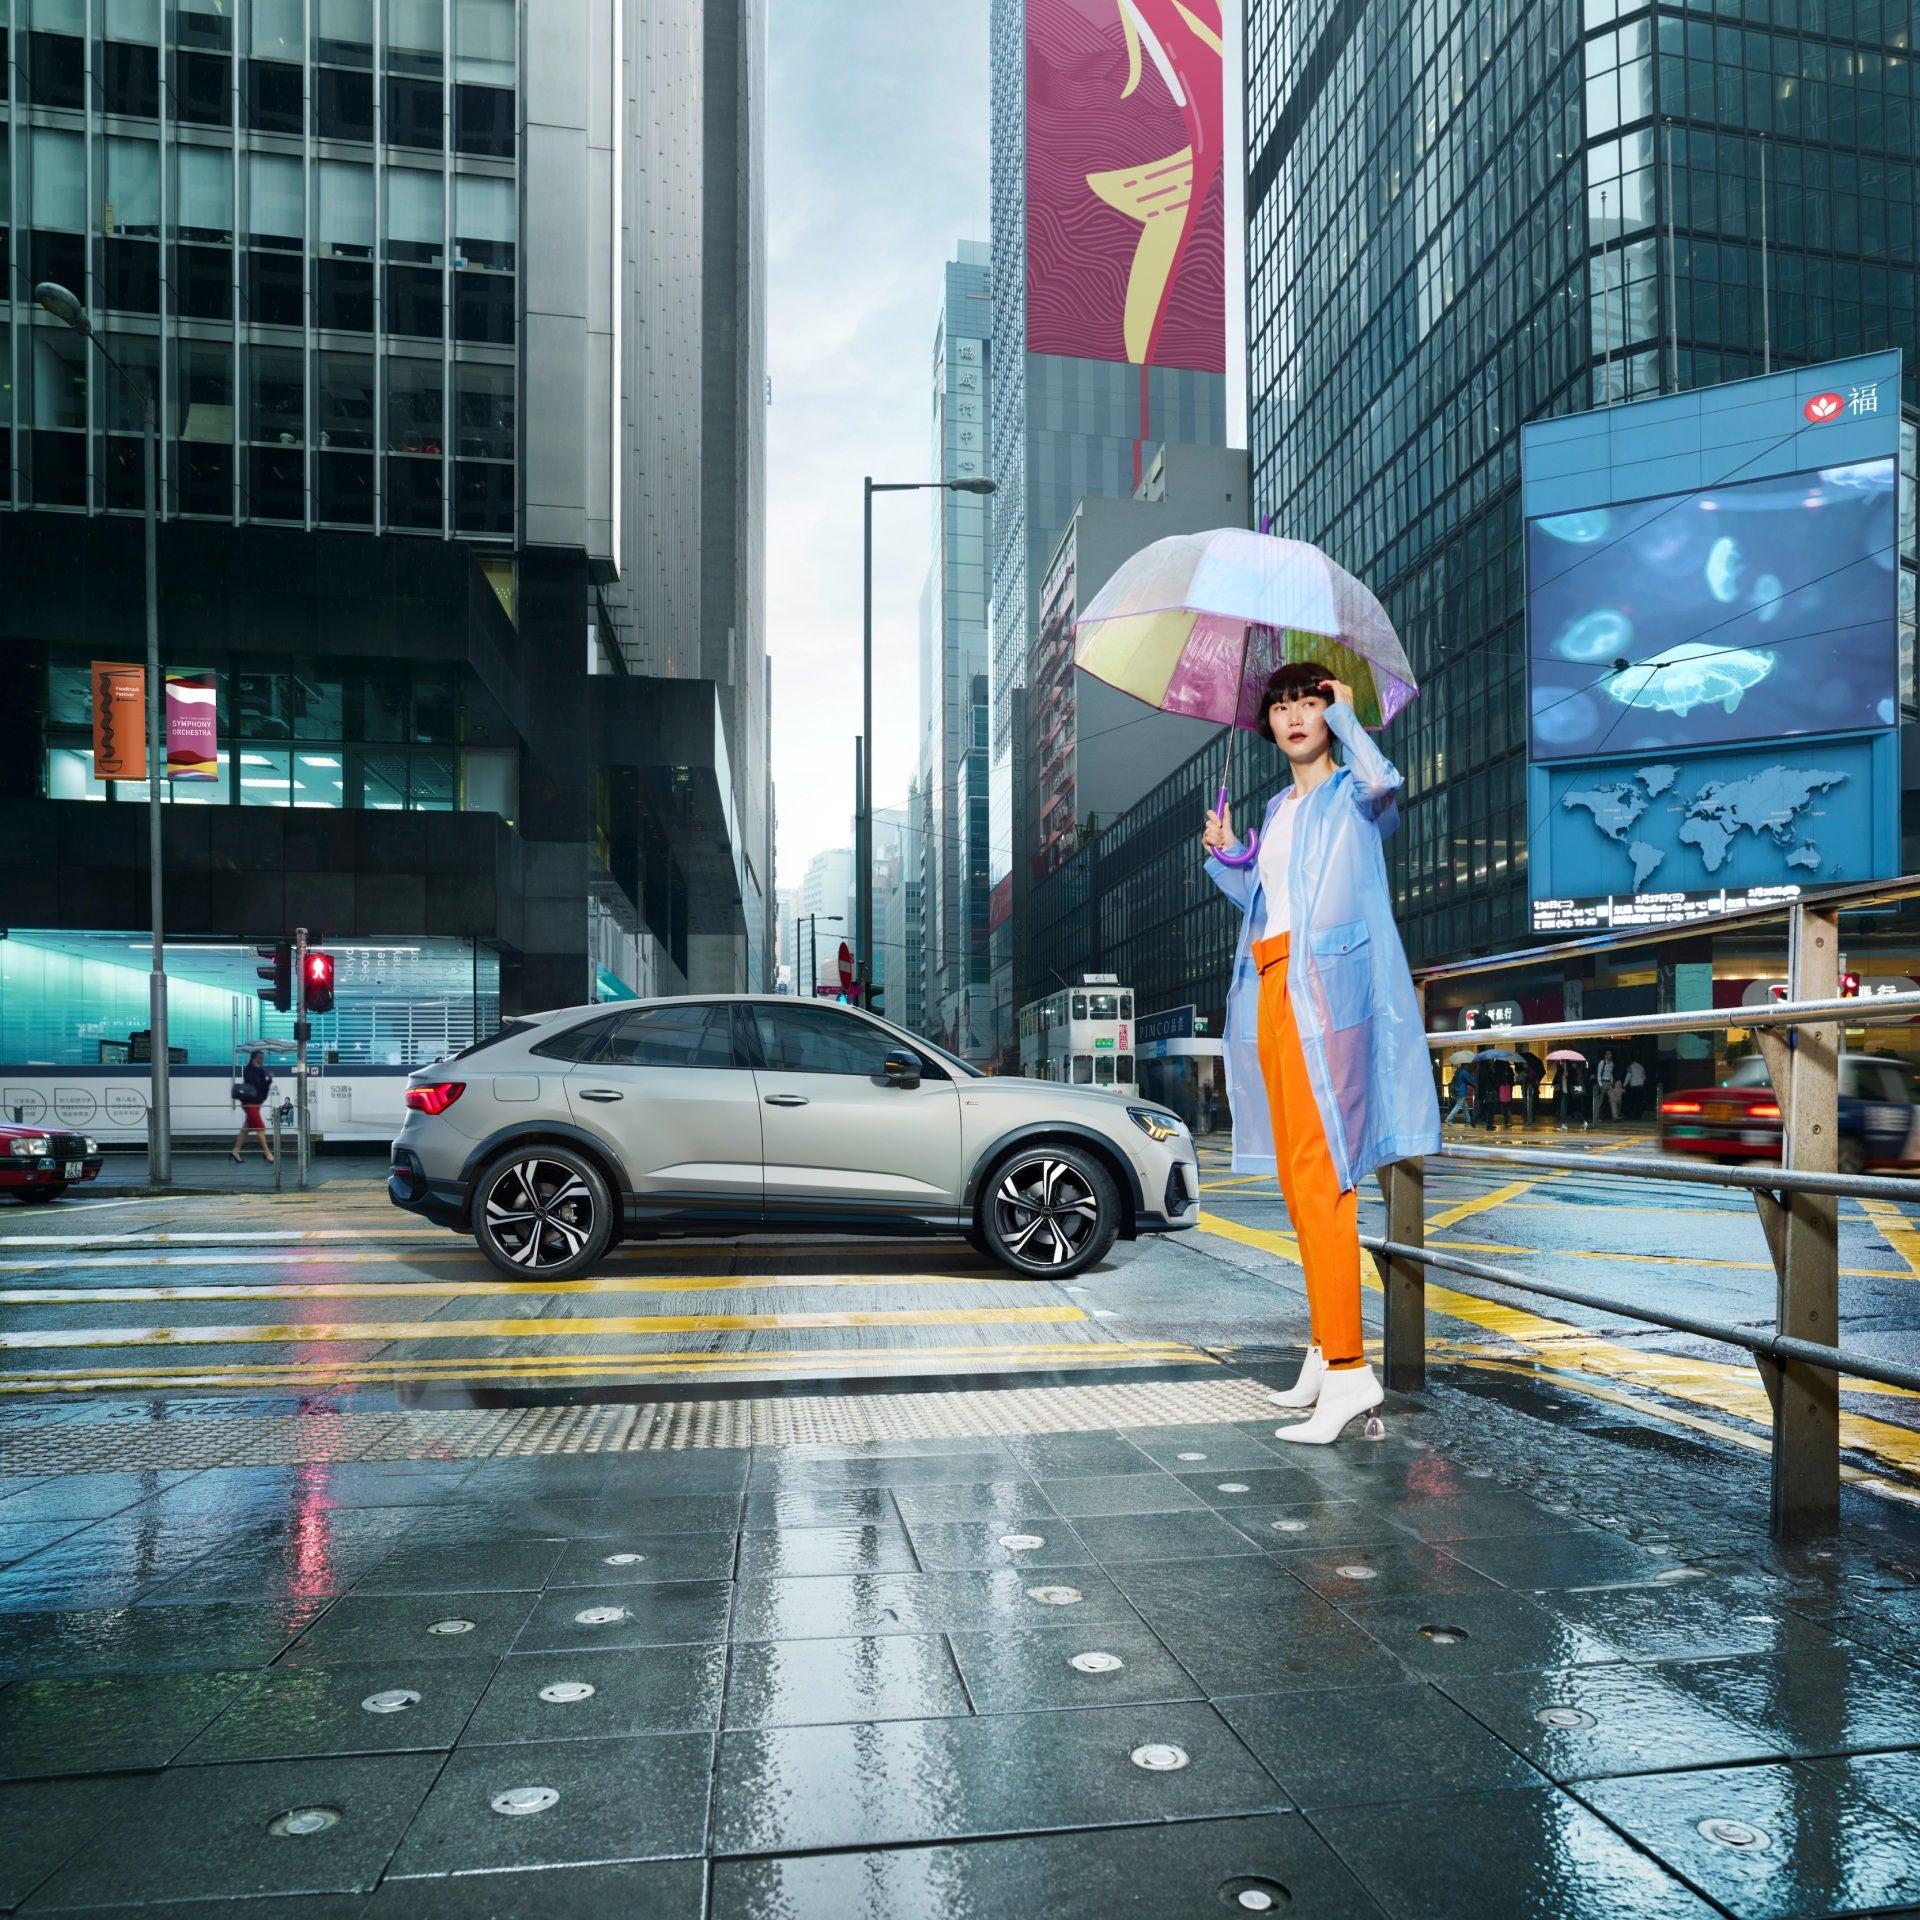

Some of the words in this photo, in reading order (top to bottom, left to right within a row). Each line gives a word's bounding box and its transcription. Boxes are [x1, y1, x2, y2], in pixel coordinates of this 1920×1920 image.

[958, 345, 975, 471] 協成行中心
[1848, 383, 1878, 416] 福
[172, 720, 212, 728] SYMPHONY
[1139, 1020, 1170, 1040] PIMCO
